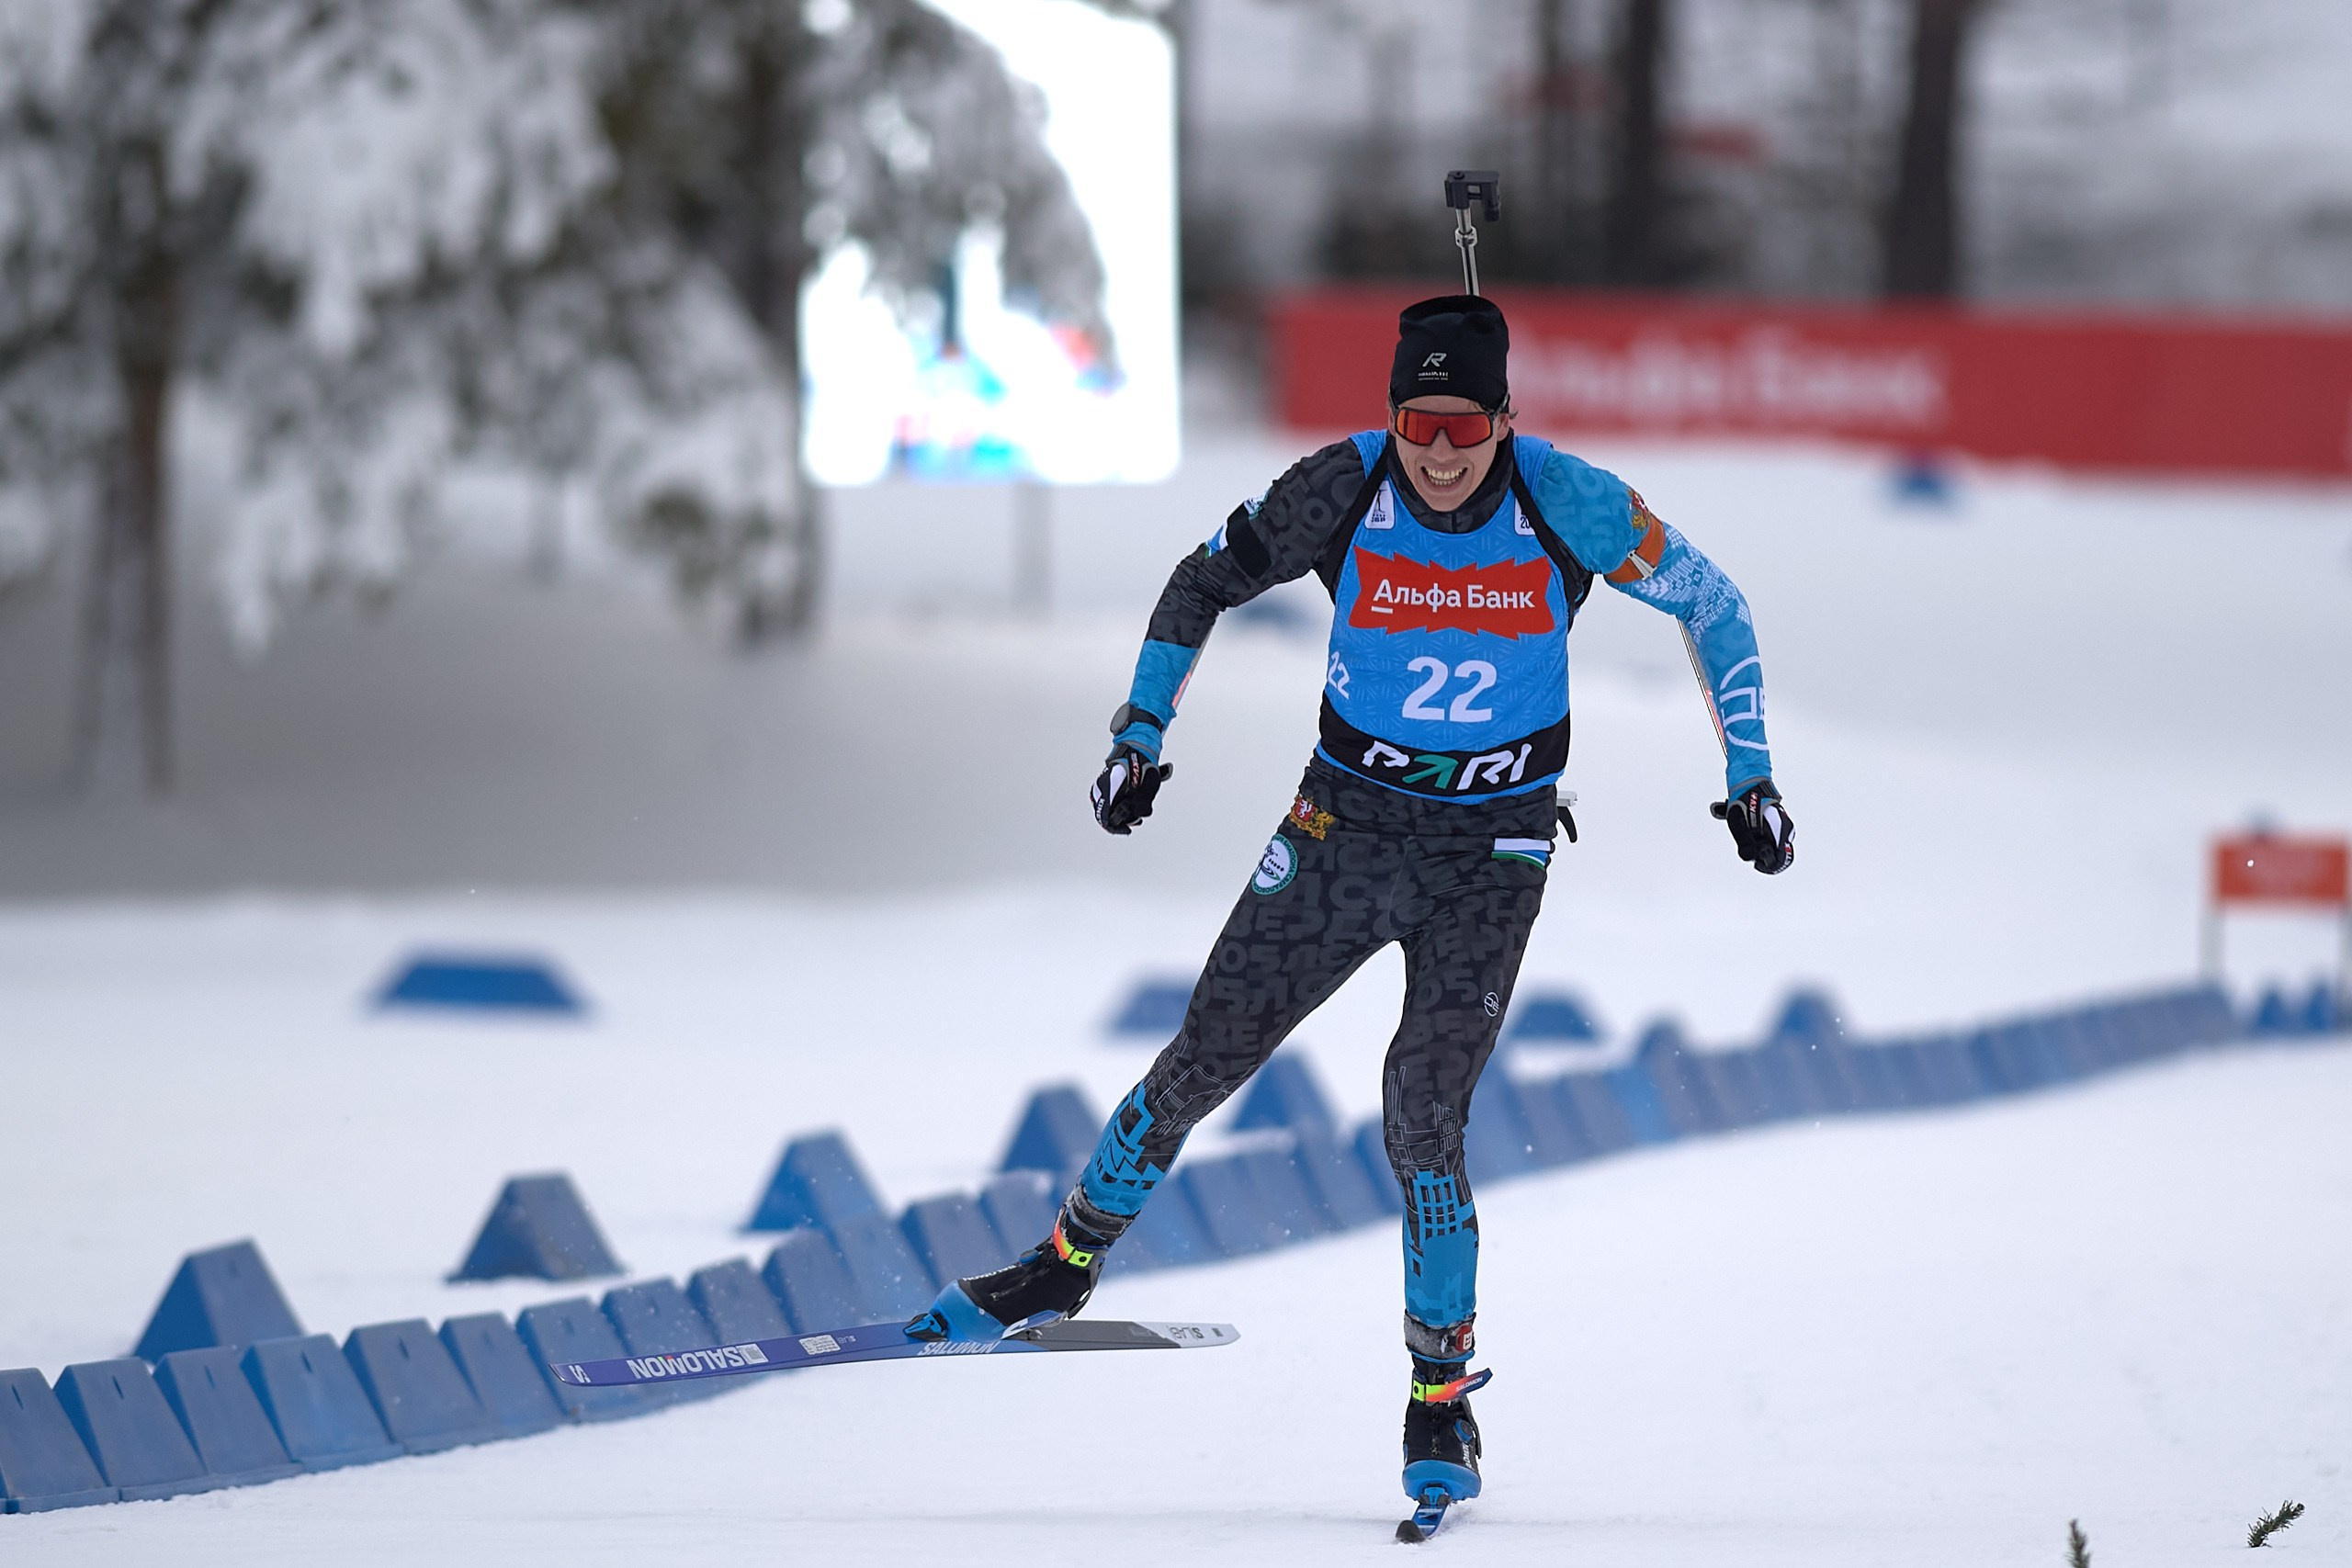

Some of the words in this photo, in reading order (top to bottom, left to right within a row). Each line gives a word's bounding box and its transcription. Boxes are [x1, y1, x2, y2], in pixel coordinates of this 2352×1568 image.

[1372, 579, 1461, 614] Альфа
[1467, 584, 1535, 609] Банк
[1327, 651, 1351, 700] 22
[1401, 656, 1498, 723] 22
[627, 1347, 745, 1379] SALOMON
